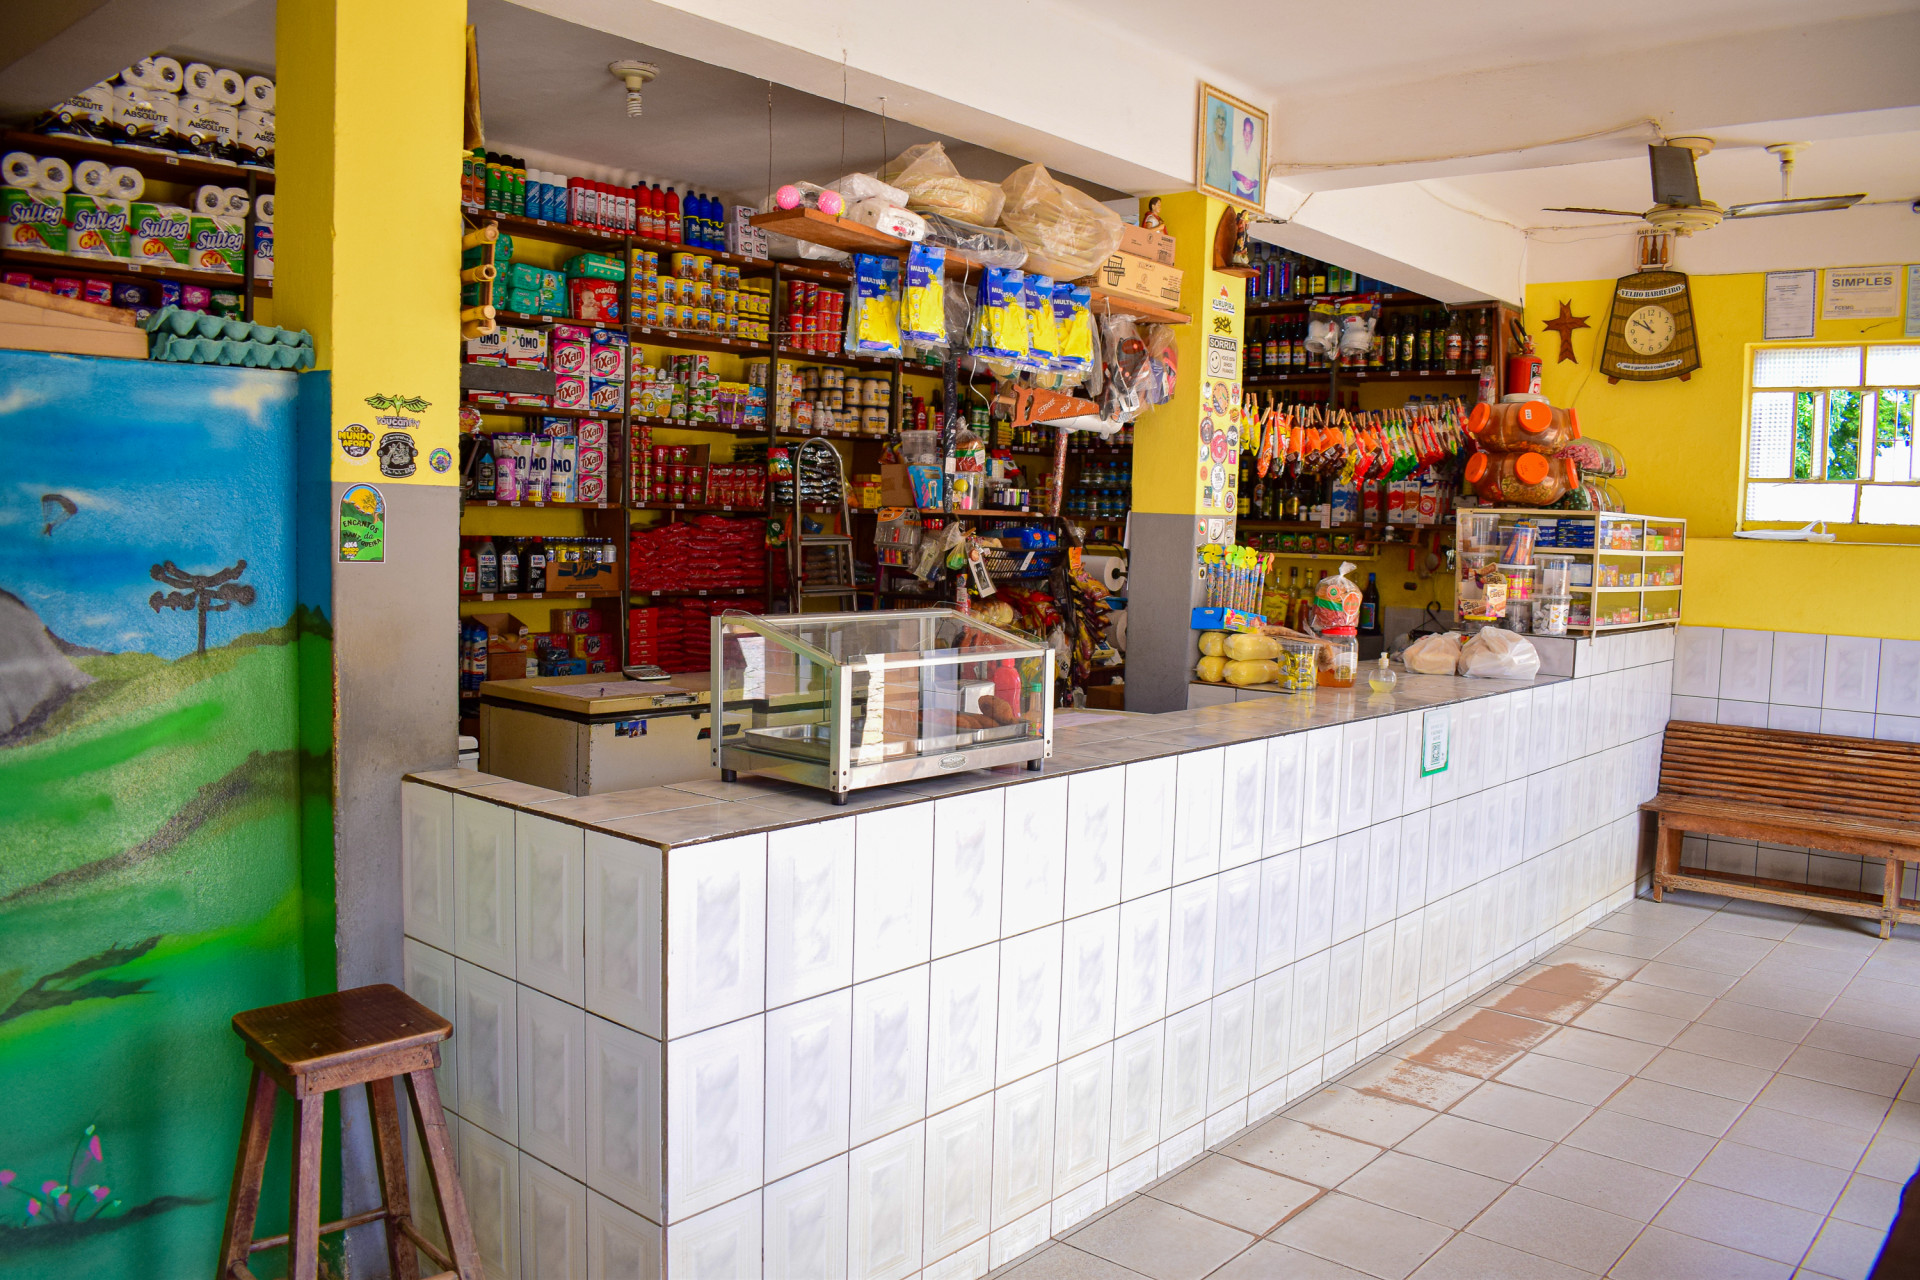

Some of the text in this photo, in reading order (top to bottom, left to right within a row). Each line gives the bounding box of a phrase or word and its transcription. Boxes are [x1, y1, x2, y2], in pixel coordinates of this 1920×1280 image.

[123, 108, 168, 122] ABSOLUTE
[187, 120, 230, 134] ABSOLUTE
[9, 202, 64, 227] Sulleg
[73, 209, 127, 233] Sulleg
[139, 218, 190, 242] Sulleg
[195, 230, 244, 252] Sulleg
[143, 240, 165, 256] 60
[201, 252, 222, 267] 60
[1832, 276, 1892, 287] SIMPLES
[1621, 285, 1681, 298] VELHO BARREIRO
[1212, 298, 1235, 310] KURUPIRA
[1647, 309, 1655, 317] 12
[480, 334, 499, 345] OMO
[520, 336, 538, 349] OMO
[1209, 338, 1236, 351] SORRIA
[338, 431, 375, 441] MUNDO
[342, 440, 371, 448] AFORA
[342, 519, 379, 534] ENCANTOS
[342, 532, 382, 548] MANTIQUEIRA
[364, 531, 374, 539] da
[1061, 660, 1069, 671] 15
